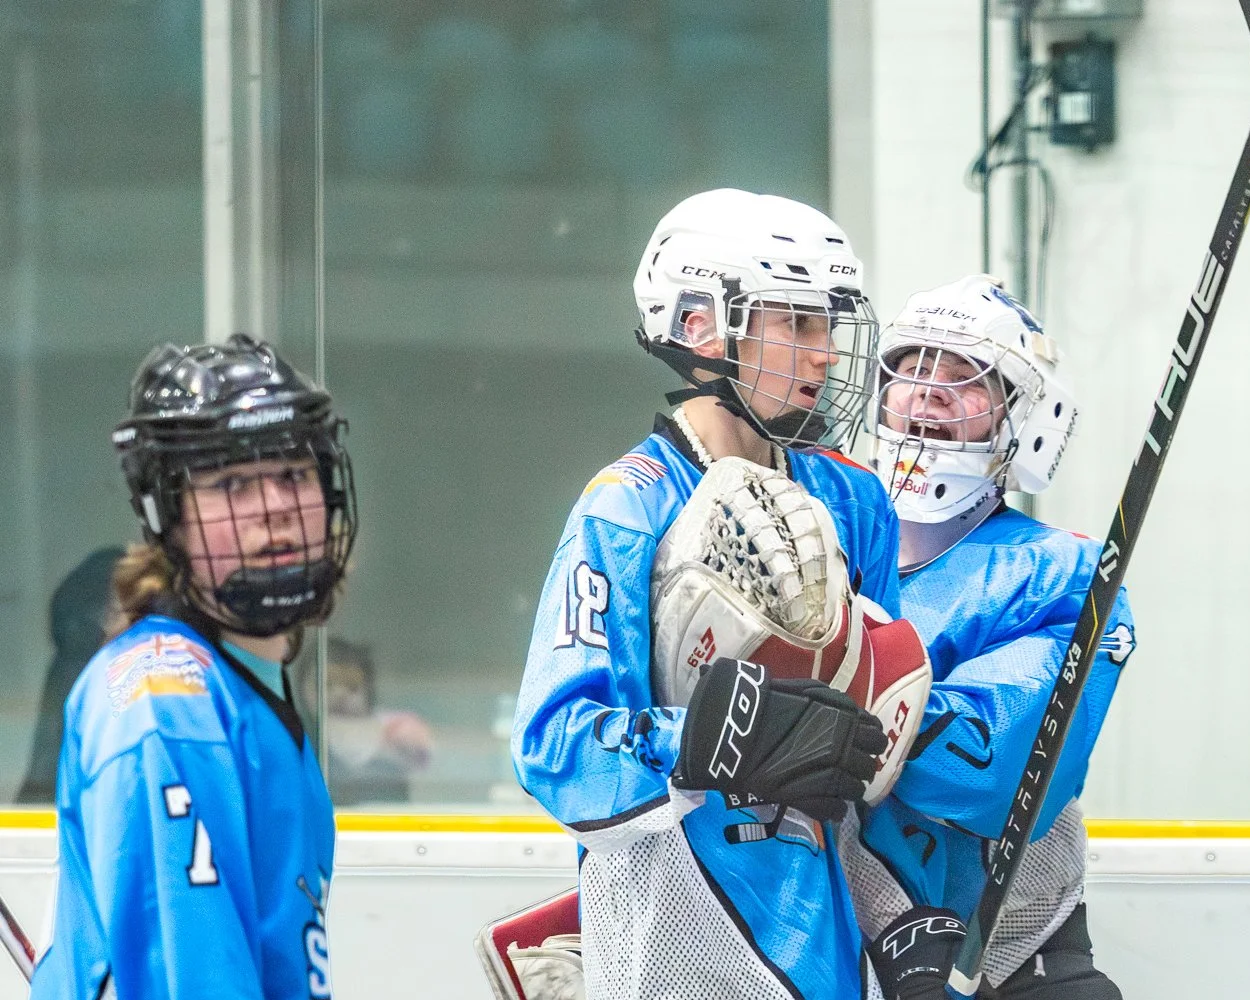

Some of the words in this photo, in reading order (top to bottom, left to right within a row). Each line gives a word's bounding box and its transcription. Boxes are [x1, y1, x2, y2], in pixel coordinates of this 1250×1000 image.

[829, 263, 857, 277] CCM
[1133, 250, 1224, 466] TRUE
[903, 478, 929, 496] Bull
[992, 691, 1065, 886] CATALYST
[1062, 642, 1083, 685] 5X3
[163, 785, 220, 887] 7
